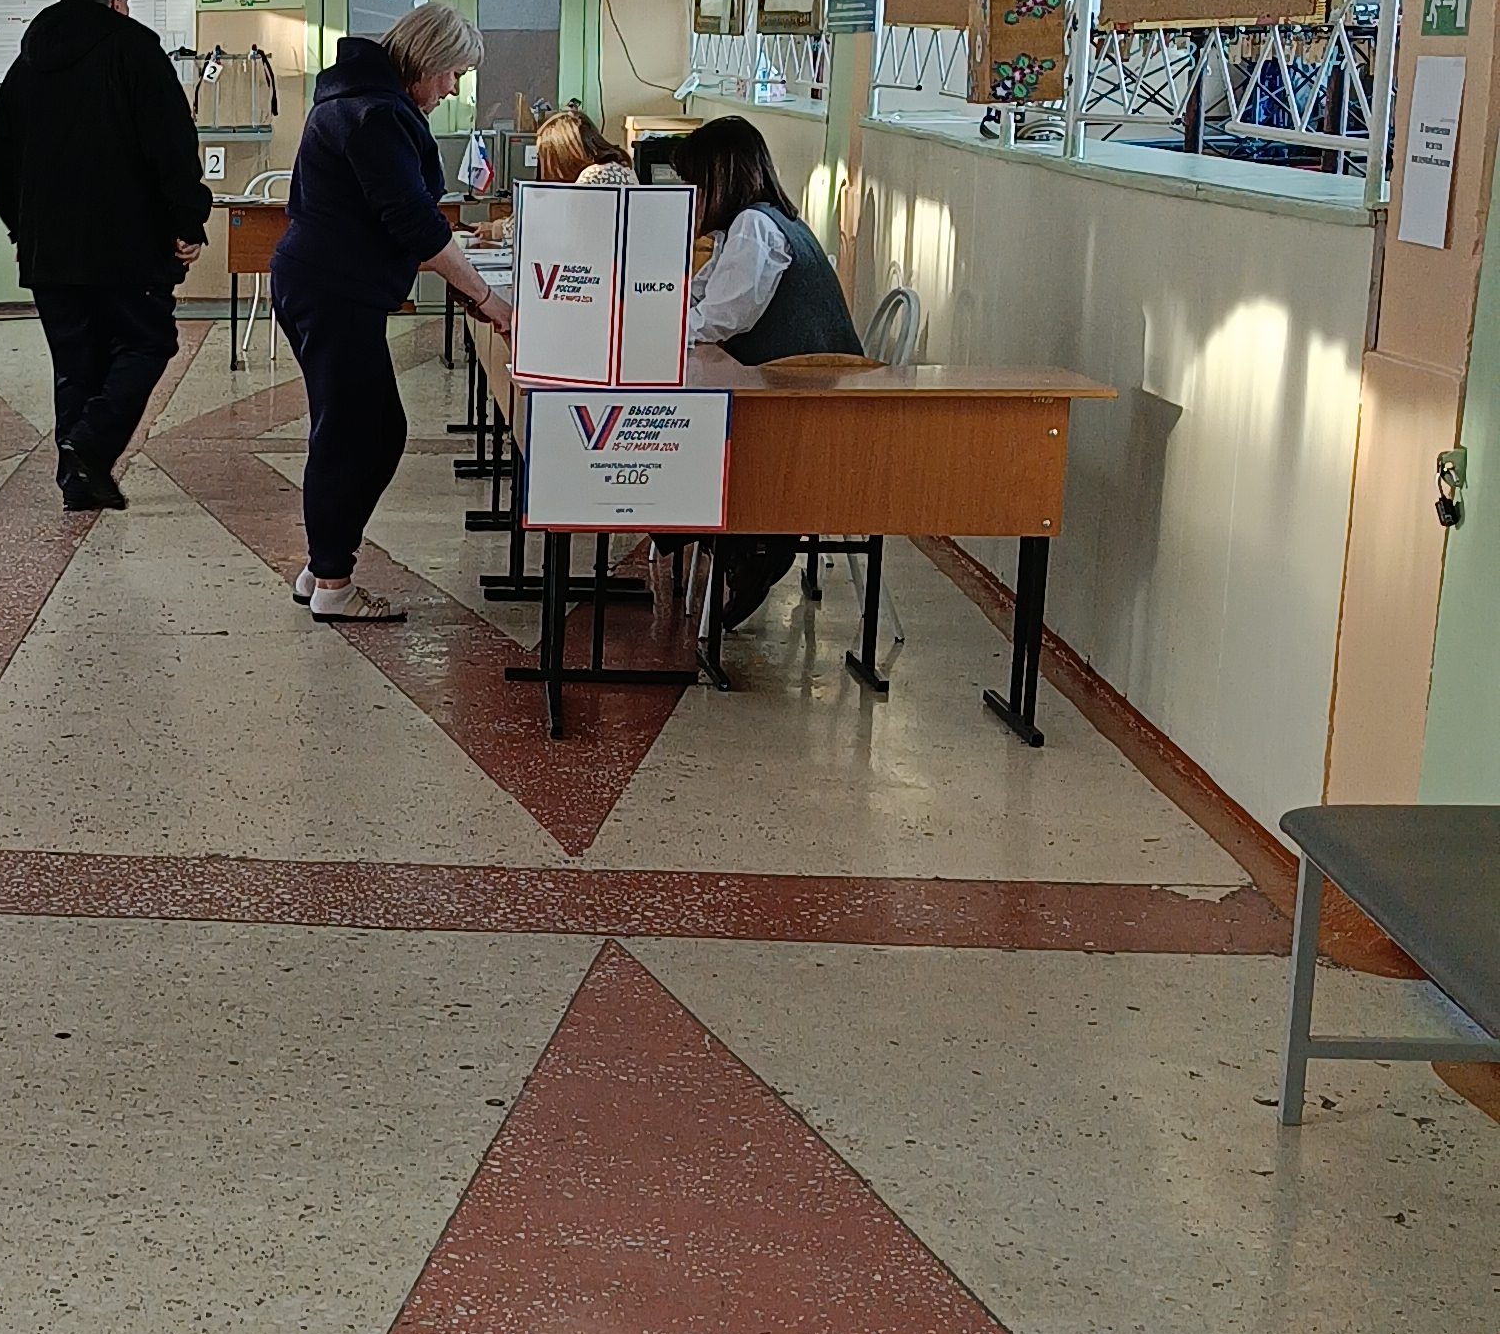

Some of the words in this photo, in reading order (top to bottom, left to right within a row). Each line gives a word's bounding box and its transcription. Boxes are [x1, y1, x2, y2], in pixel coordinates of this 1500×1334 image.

[206, 66, 218, 80] 2
[208, 154, 221, 174] 2
[562, 265, 592, 274] ВЫБОРЫ
[558, 275, 601, 285] ПРЕЗИДЕНТА
[555, 284, 582, 293] РОССИИ
[634, 282, 675, 294] ЦИК.РФ
[628, 406, 677, 416] ВЫБОРЫ
[622, 418, 690, 429] ПРЕЗИДЕНТА
[616, 430, 660, 440] РОССИИ
[633, 443, 660, 451] МАРТА
[660, 443, 680, 452] 2024
[616, 469, 649, 484] 606
